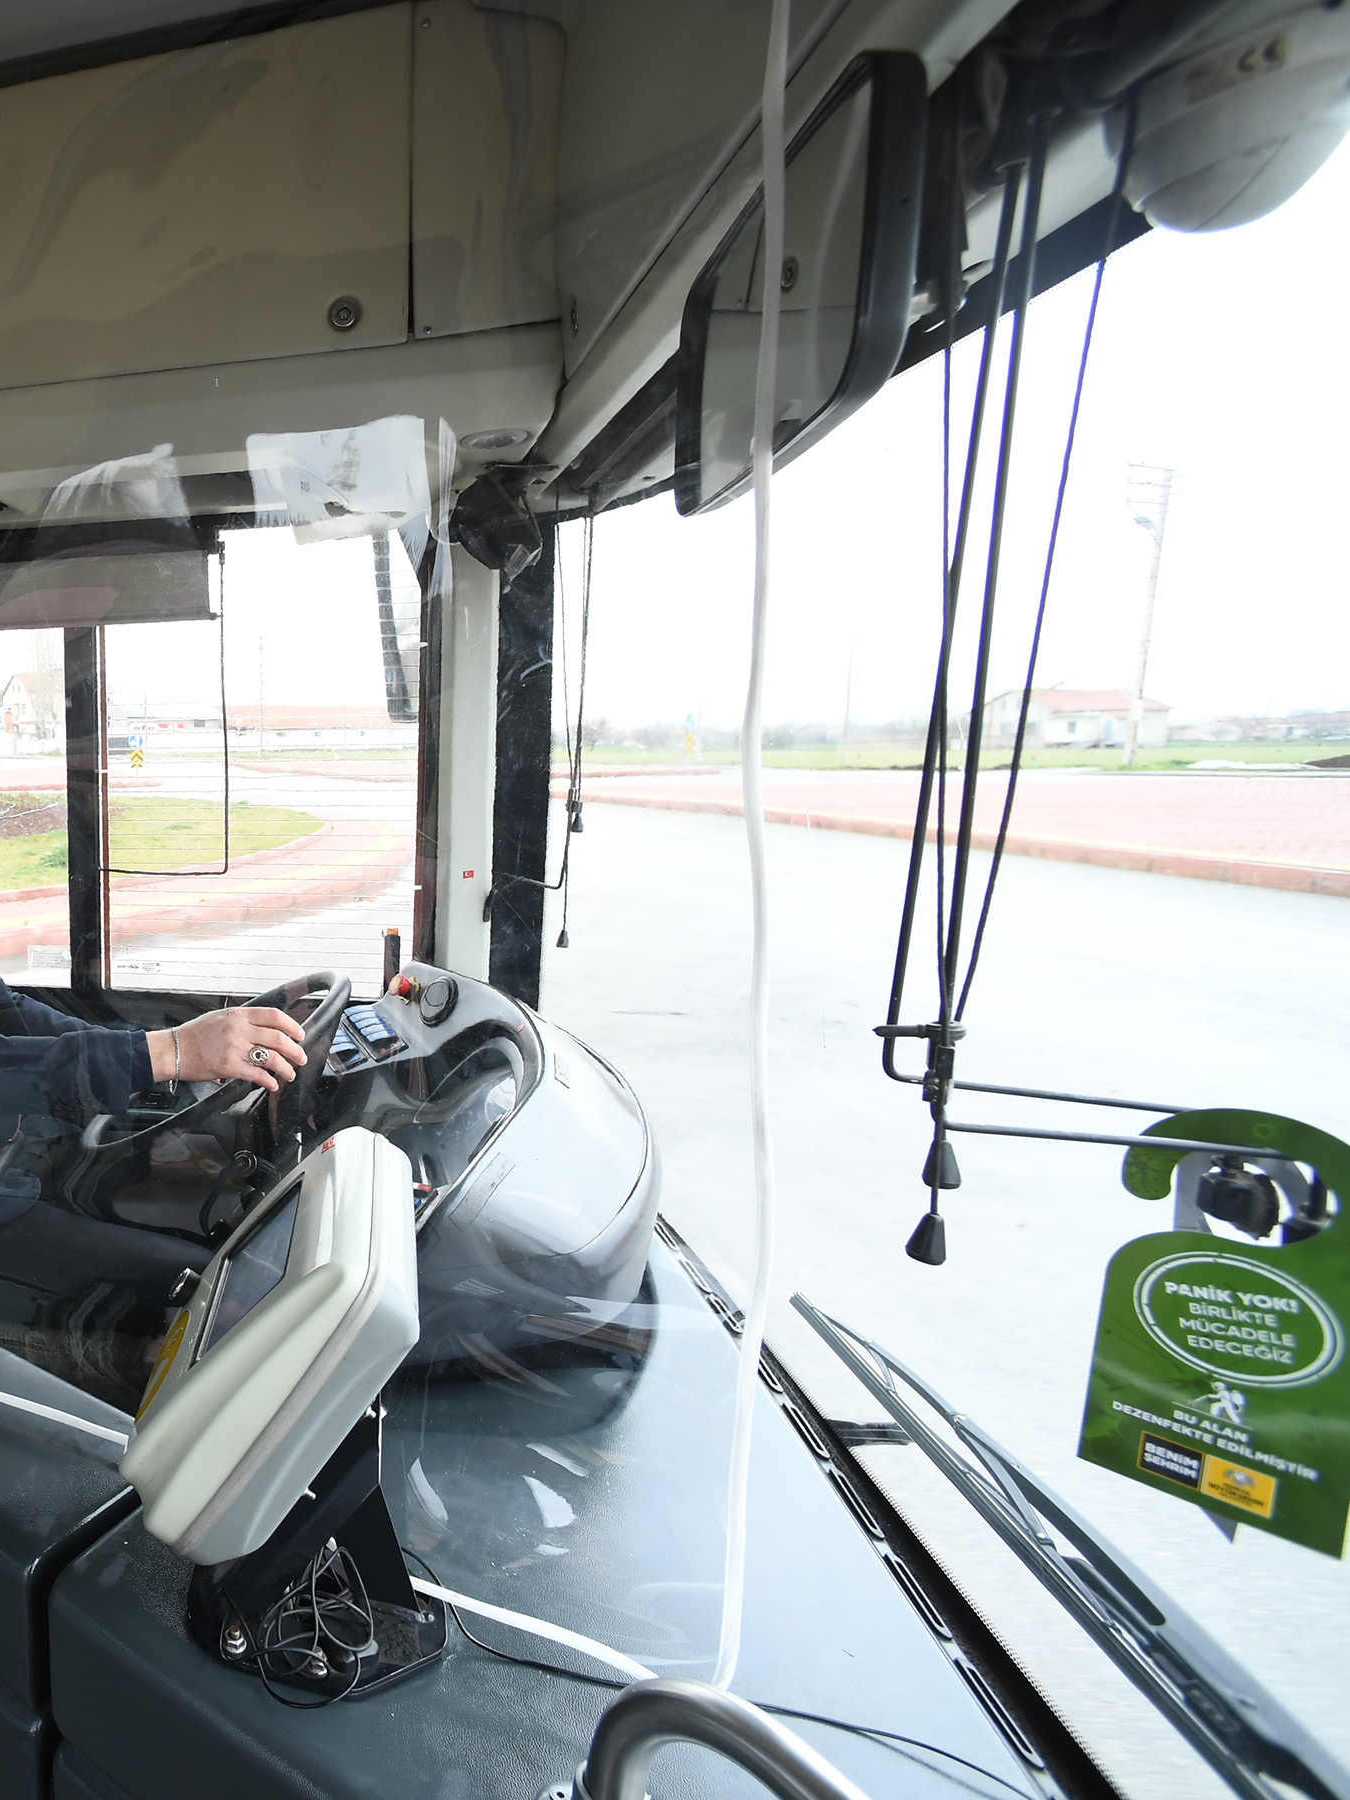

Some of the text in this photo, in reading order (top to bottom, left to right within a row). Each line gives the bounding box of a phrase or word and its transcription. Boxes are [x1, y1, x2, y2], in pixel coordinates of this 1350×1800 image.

[1164, 1281, 1300, 1314] PANİK YOK!
[1188, 1301, 1278, 1328] BİRLİKTE
[1178, 1317, 1296, 1348] MÜCADELE
[1187, 1335, 1295, 1366] EDECEĞİZ
[1112, 1400, 1215, 1445] DEZENFEKTE
[1173, 1409, 1251, 1444] BU ALAN
